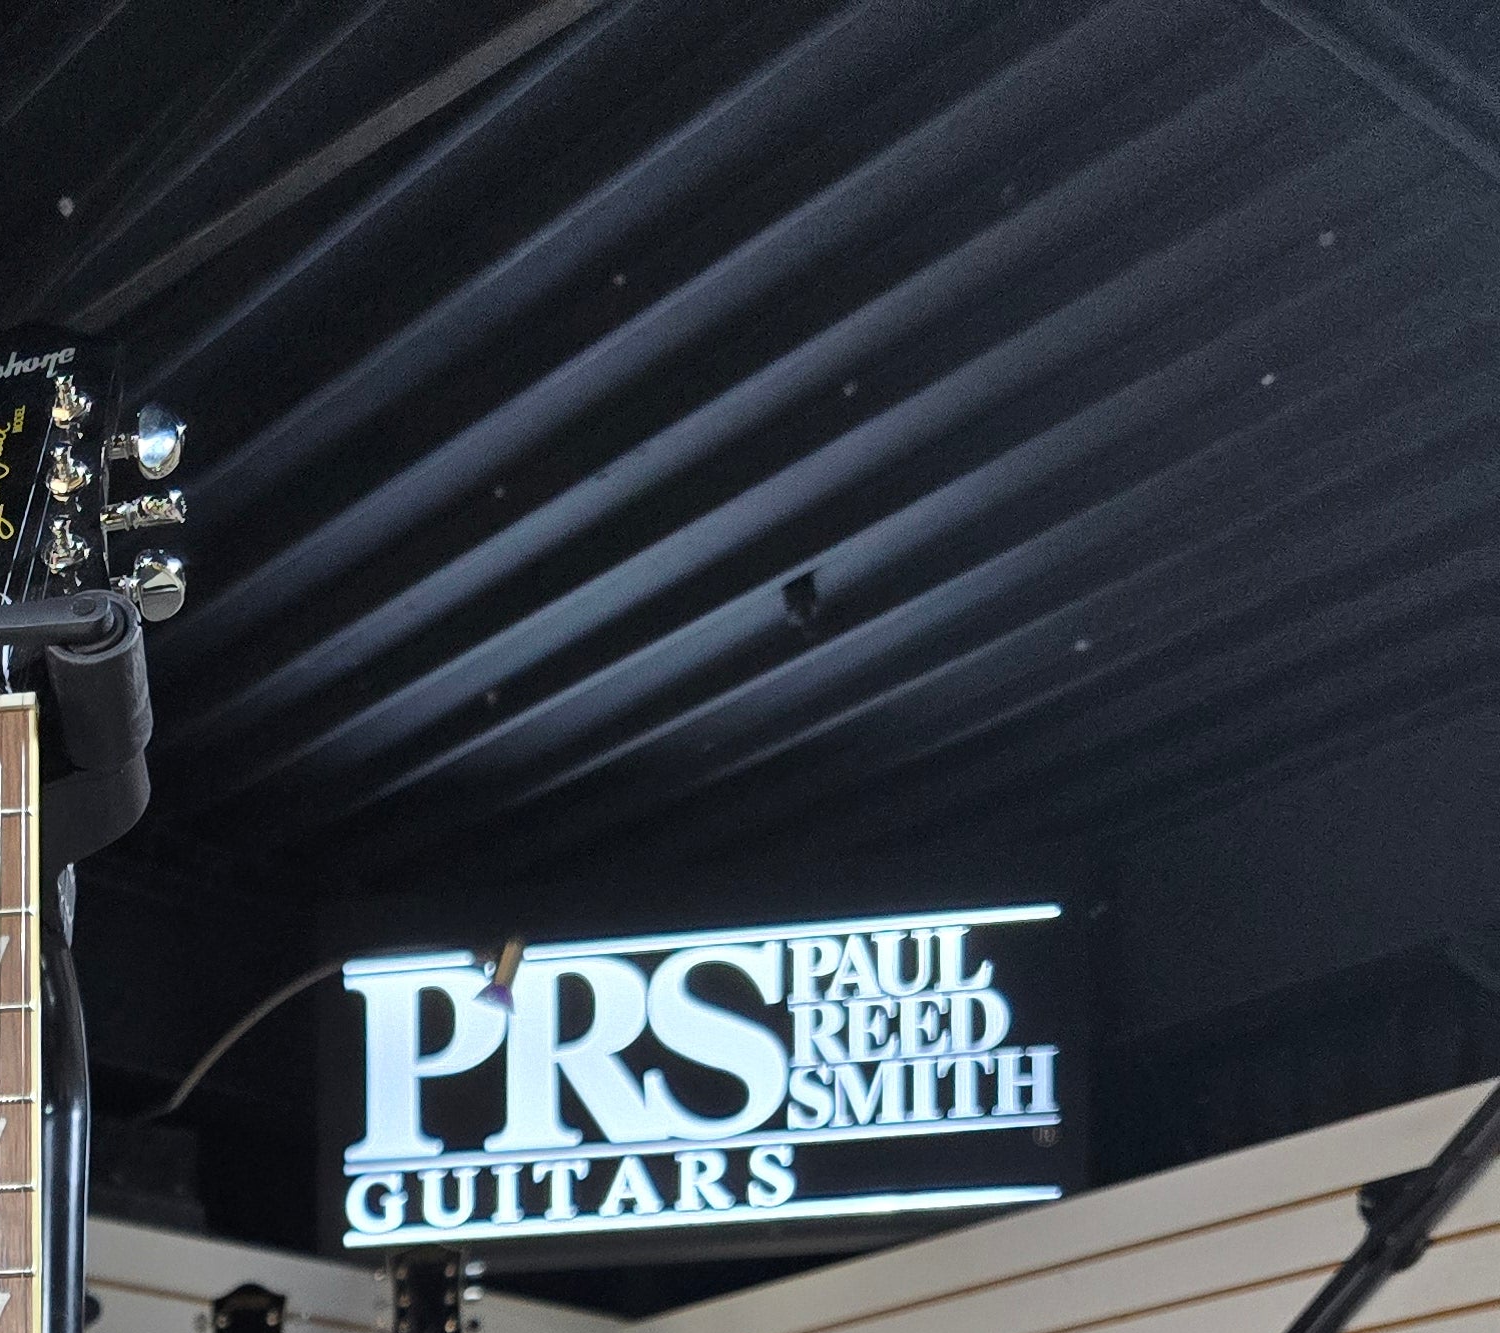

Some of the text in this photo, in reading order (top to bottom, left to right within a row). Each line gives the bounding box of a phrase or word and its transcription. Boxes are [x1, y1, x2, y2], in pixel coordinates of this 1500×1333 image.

[785, 925, 993, 1005] PAUL
[344, 941, 789, 1162] PRS
[788, 988, 1012, 1066] REED
[787, 1046, 1059, 1131] SMITH
[345, 1144, 798, 1234] GUITARS
